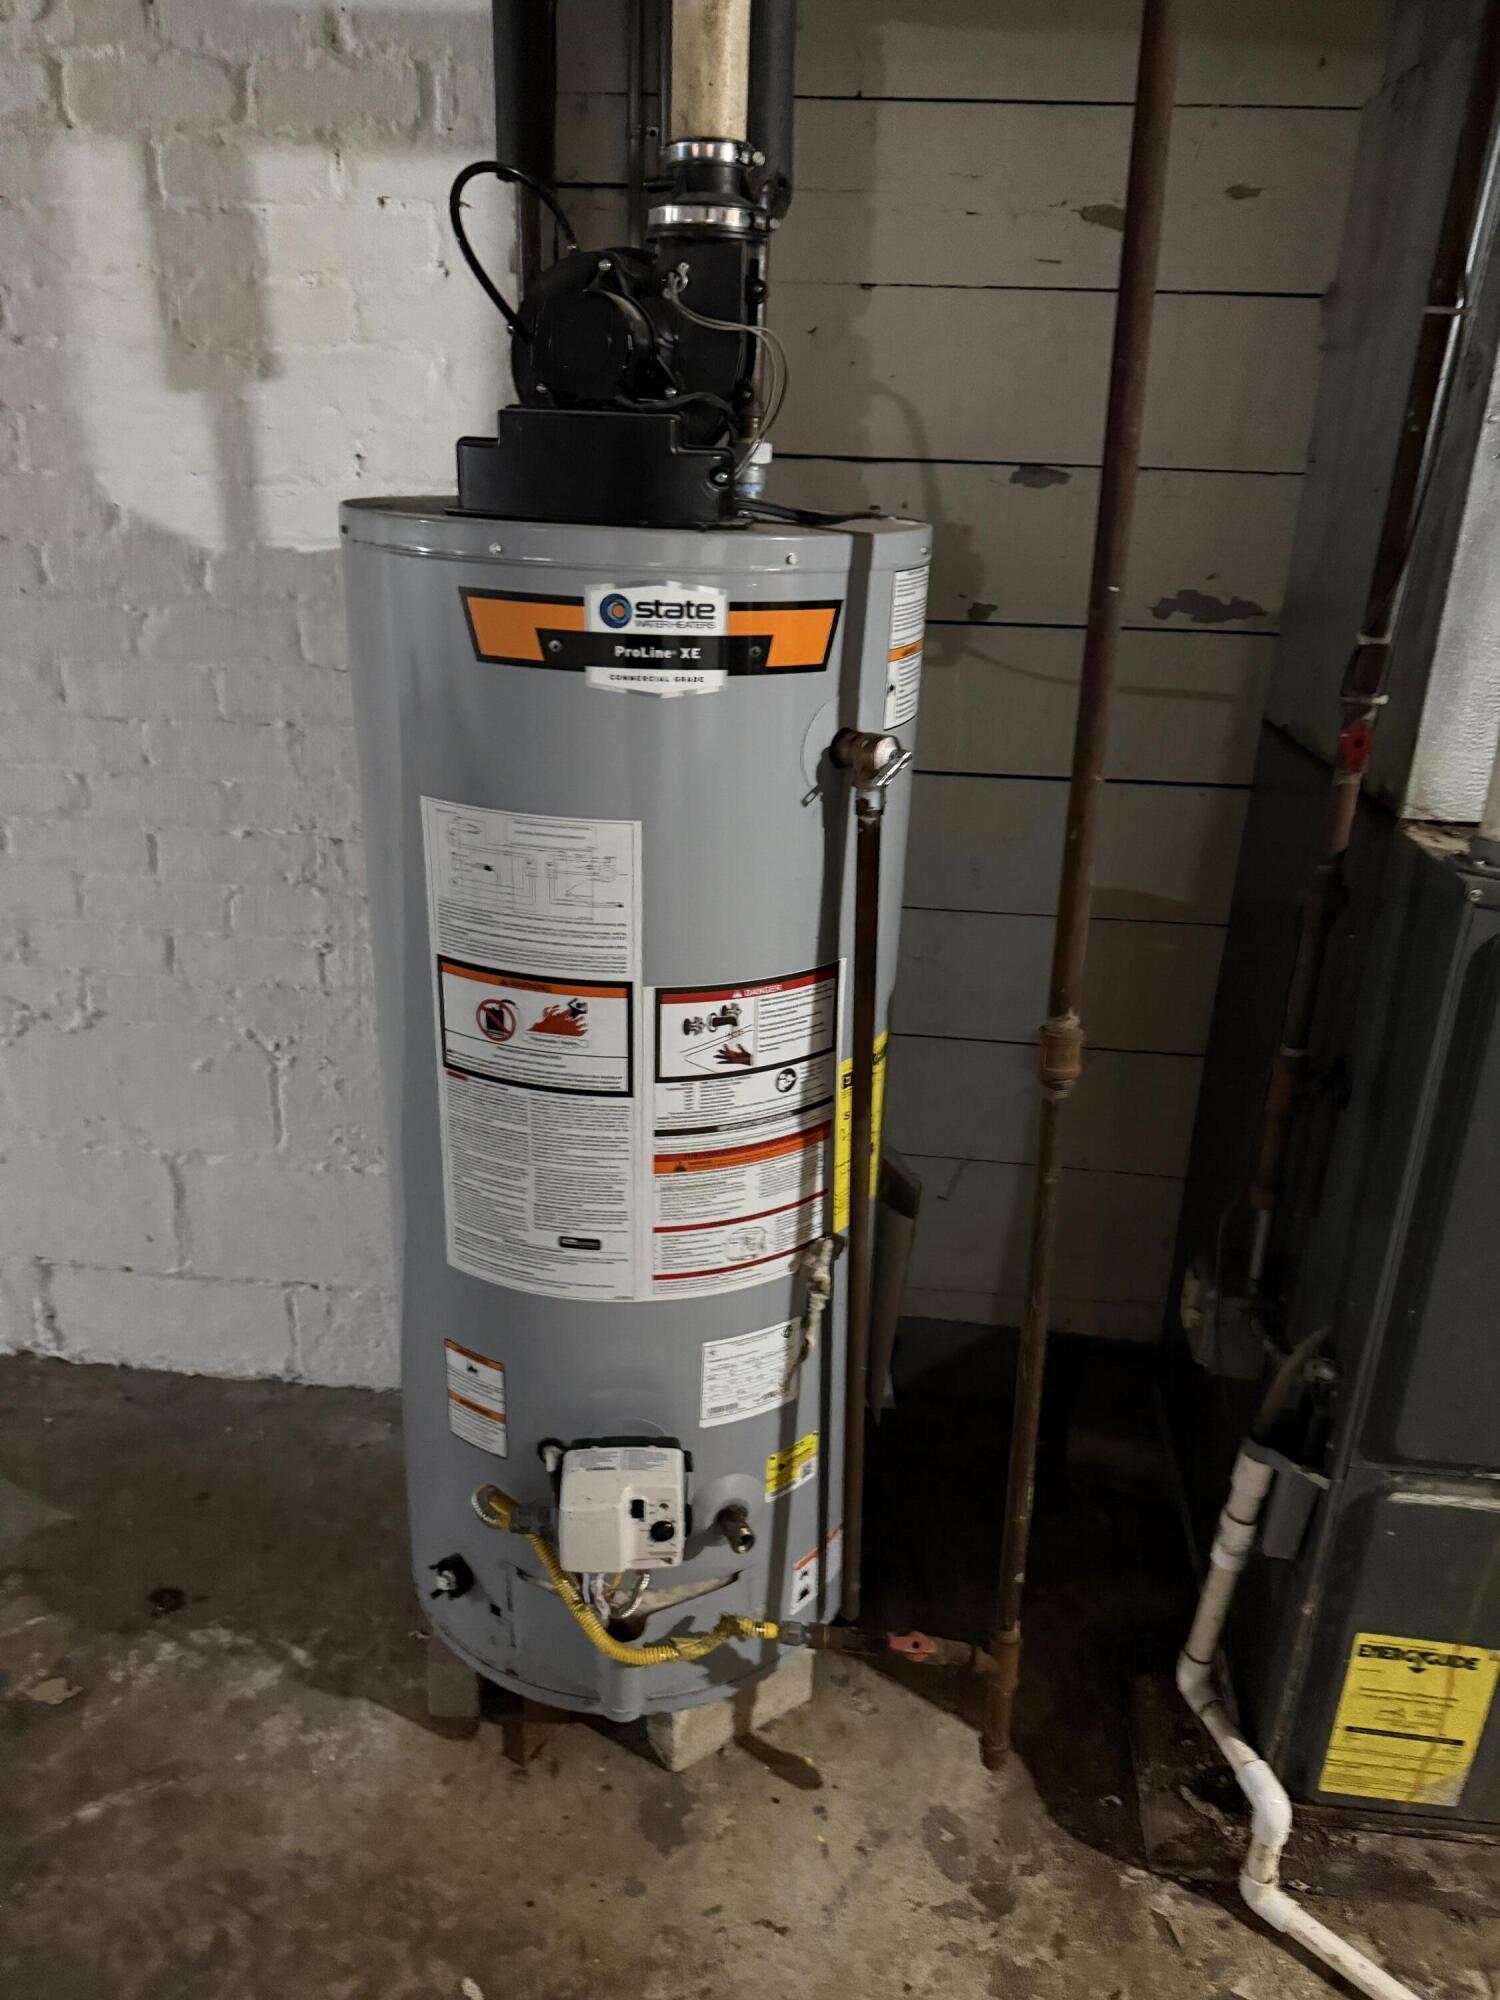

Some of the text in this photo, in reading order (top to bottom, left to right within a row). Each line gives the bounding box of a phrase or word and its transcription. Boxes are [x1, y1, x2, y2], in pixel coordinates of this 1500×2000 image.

[635, 600, 716, 620] state
[671, 620, 716, 629] HEATERS
[680, 648, 701, 659] XE
[609, 674, 670, 682] COMMERCIAL
